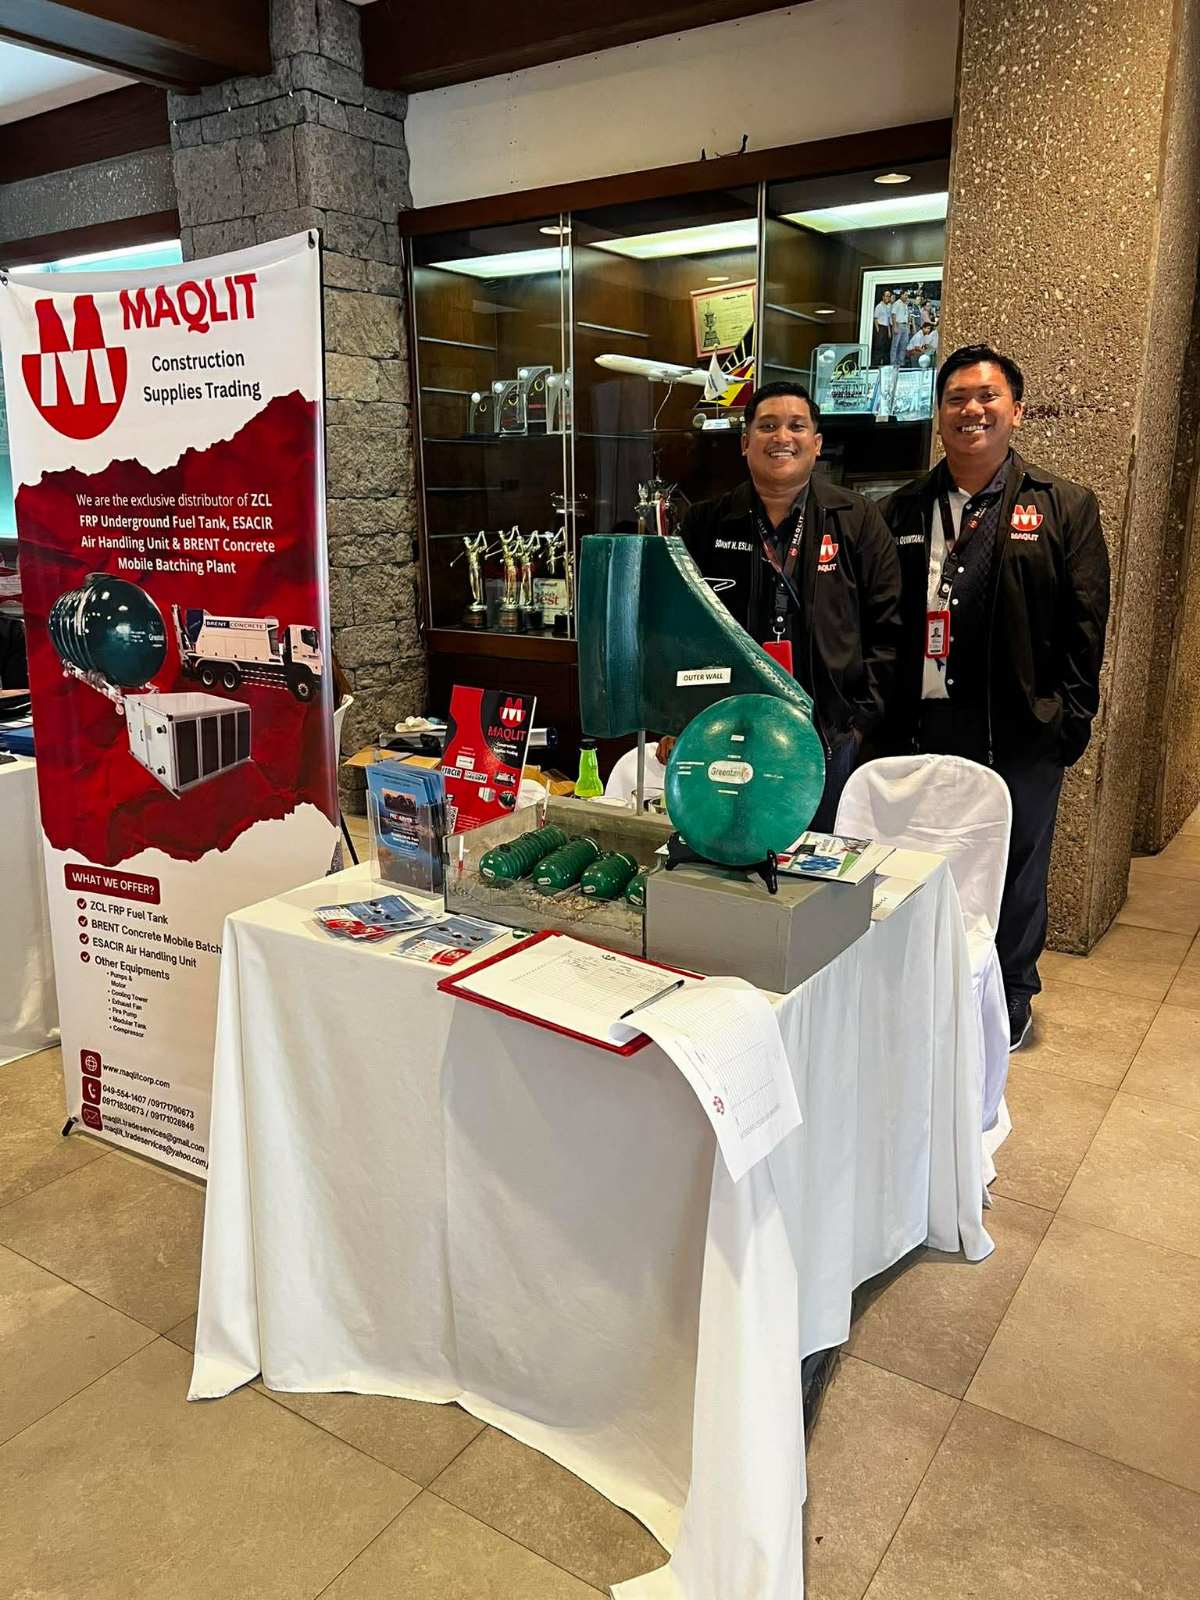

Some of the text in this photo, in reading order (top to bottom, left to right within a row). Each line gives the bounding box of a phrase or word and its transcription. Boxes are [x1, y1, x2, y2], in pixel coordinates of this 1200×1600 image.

[119, 273, 258, 333] MAQLIT
[152, 350, 245, 372] Construction
[143, 380, 262, 405] Supplies Trading
[76, 493, 273, 508] We are the exclusive distributor of ZCL
[79, 514, 274, 531] FRP Underground Fuel Tank, ESACIR
[81, 535, 275, 553] Air Handling Unit & BRENT Concrete
[1010, 532, 1039, 541] MAQLIT
[118, 557, 237, 576] Mobile Batching Plant
[817, 563, 837, 573] AQLIT
[488, 725, 527, 741] MAQLIT
[72, 872, 155, 896] WHAT WE OFFER?
[90, 900, 169, 925] ZCL FRP Fuel Tank
[91, 919, 223, 954] BRENT Concrete Mobile Batch
[92, 937, 197, 968] ESACIR Air Handling Unit
[94, 955, 170, 980] Other Equipments
[102, 1063, 170, 1088] www.maqlitcorp.com
[102, 1084, 146, 1104] 049-554-1407
